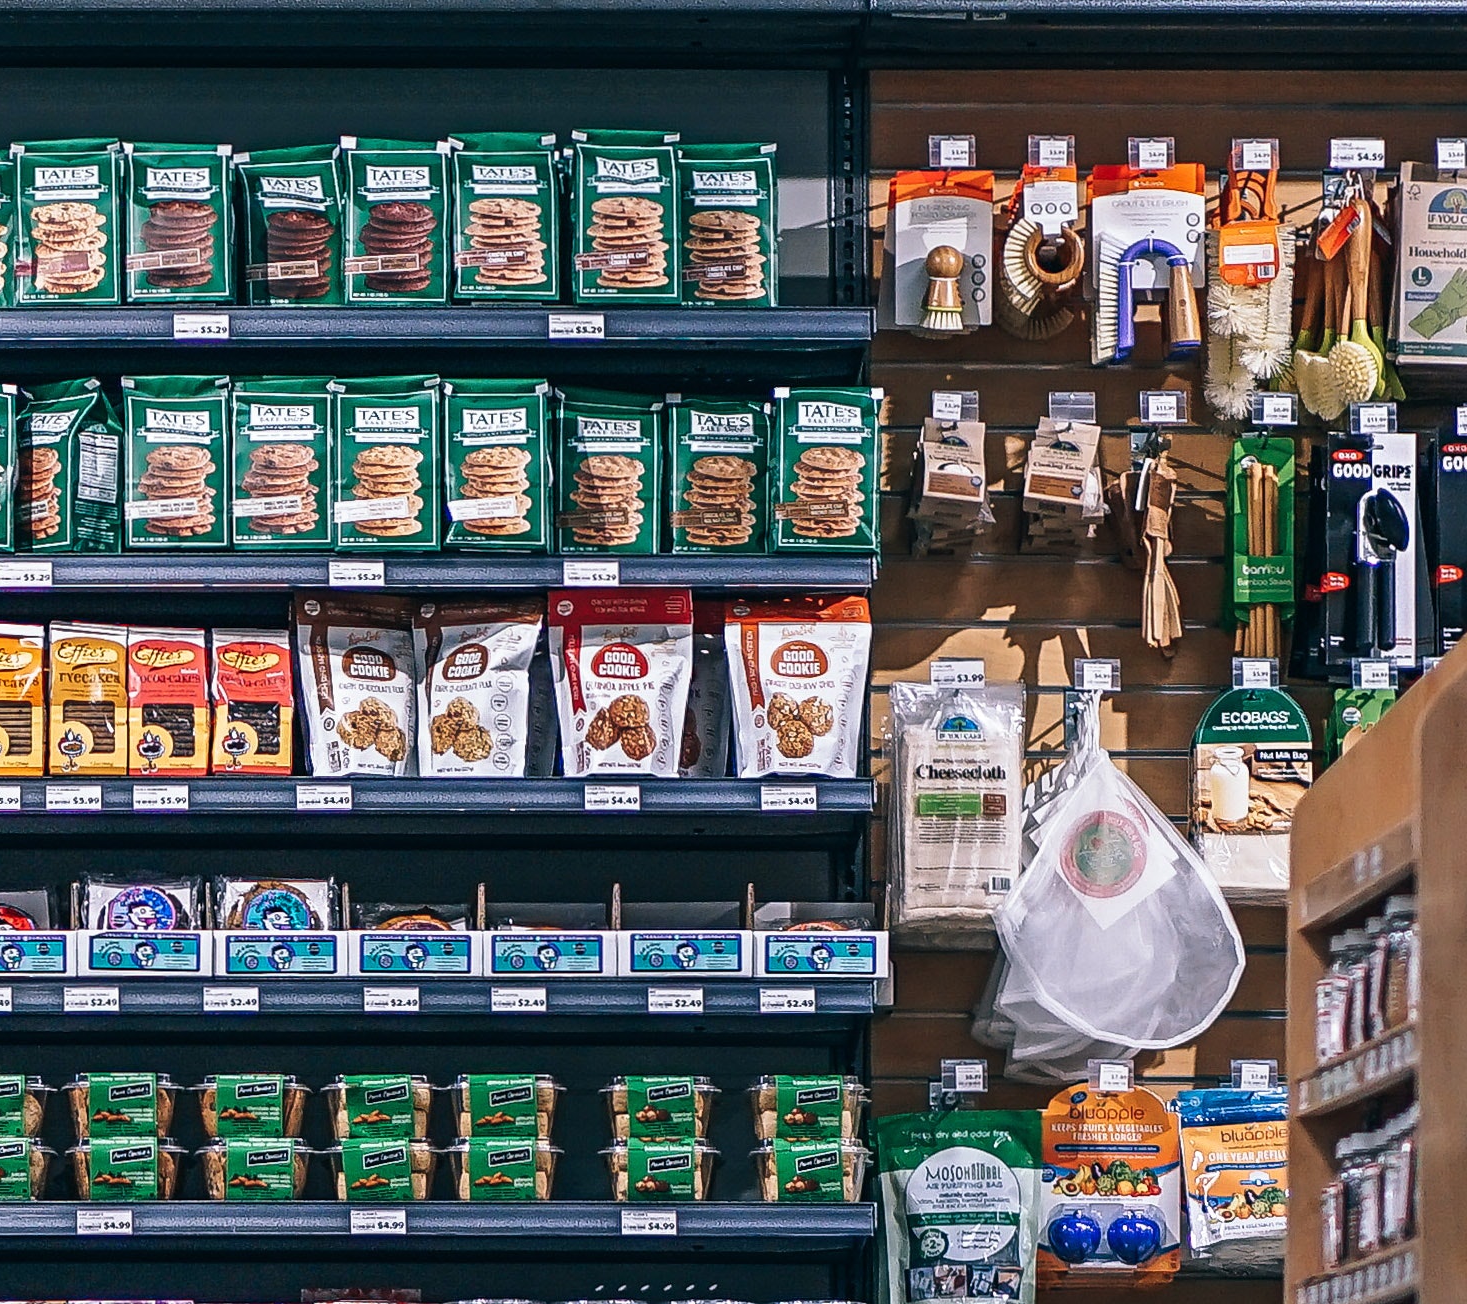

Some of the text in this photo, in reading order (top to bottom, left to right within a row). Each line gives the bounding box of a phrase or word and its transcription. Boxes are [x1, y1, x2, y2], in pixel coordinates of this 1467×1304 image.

[1357, 153, 1384, 161] $4.59
[598, 158, 659, 174] TATE'S
[149, 169, 211, 184] TATE'S
[367, 168, 426, 182] TATE'S
[1428, 214, 1436, 222] IF
[1438, 215, 1459, 224] YOU
[1409, 246, 1467, 260] Household
[798, 404, 858, 419] TATE'S
[1333, 464, 1411, 478] GOOD GRIPS
[592, 572, 617, 581] $5.29
[1241, 564, 1285, 576] bambu
[603, 650, 636, 663] GOOD
[782, 649, 816, 662] GOOD
[599, 661, 642, 677] COOKIE
[776, 660, 822, 676] COOKIE
[957, 673, 984, 684] $3.99
[1221, 711, 1287, 724] ECOBAGS
[1259, 751, 1308, 761] Nut Milk Bag
[916, 764, 1006, 780] Cheesecloth
[611, 796, 638, 805] $4.49
[1069, 1101, 1145, 1122] bluapple
[1073, 1132, 1143, 1142] FRESHER LONGER
